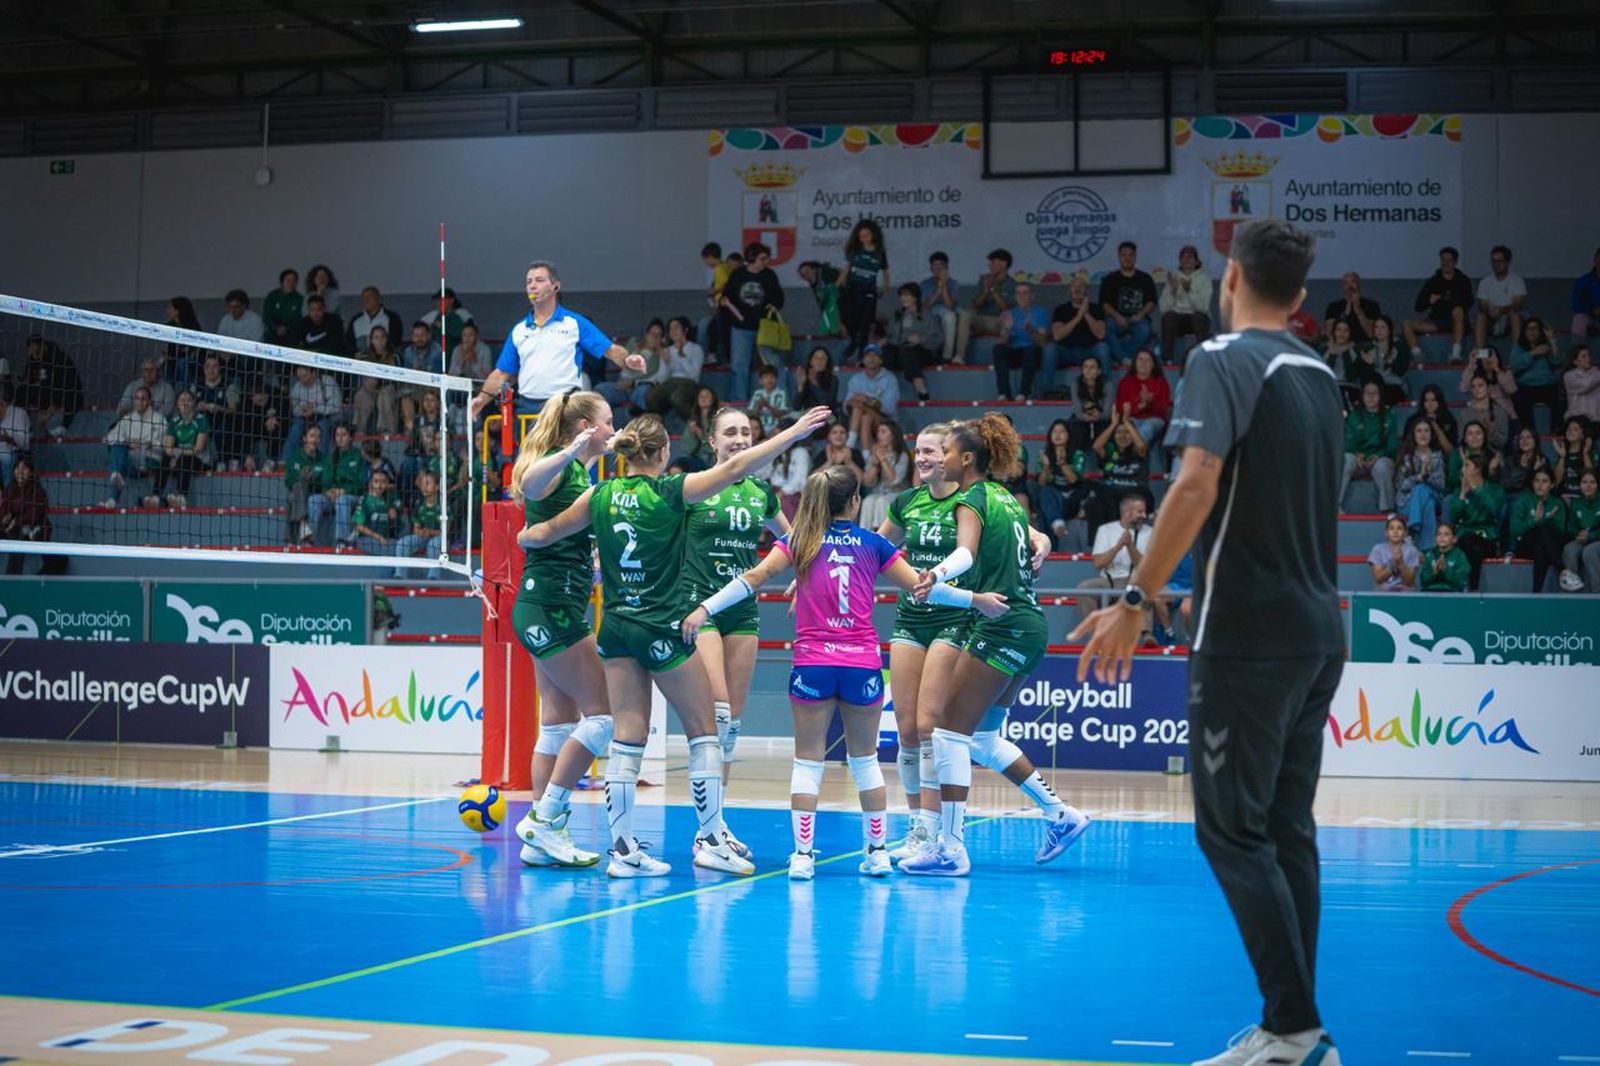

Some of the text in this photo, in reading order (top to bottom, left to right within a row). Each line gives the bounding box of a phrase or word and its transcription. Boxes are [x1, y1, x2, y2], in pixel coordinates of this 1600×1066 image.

[812, 185, 961, 209] Ayuntamiento de
[1285, 178, 1441, 200] Ayuntamiento de
[813, 213, 852, 230] Dos
[1025, 211, 1117, 224] Dos Hermanas
[1286, 203, 1441, 222] Dos Hermanas
[725, 506, 750, 531] 10
[714, 537, 756, 550] Fundación
[918, 521, 942, 546] 14
[613, 522, 642, 568] 2
[621, 572, 646, 582] WAY
[830, 566, 851, 614] 1
[46, 608, 131, 630] Diputación
[261, 610, 352, 634] Diputación
[826, 617, 856, 628] WAY
[1485, 630, 1593, 652] Diputación
[1019, 681, 1132, 712] olleyball
[1001, 718, 1189, 748] lenge Cup 202
